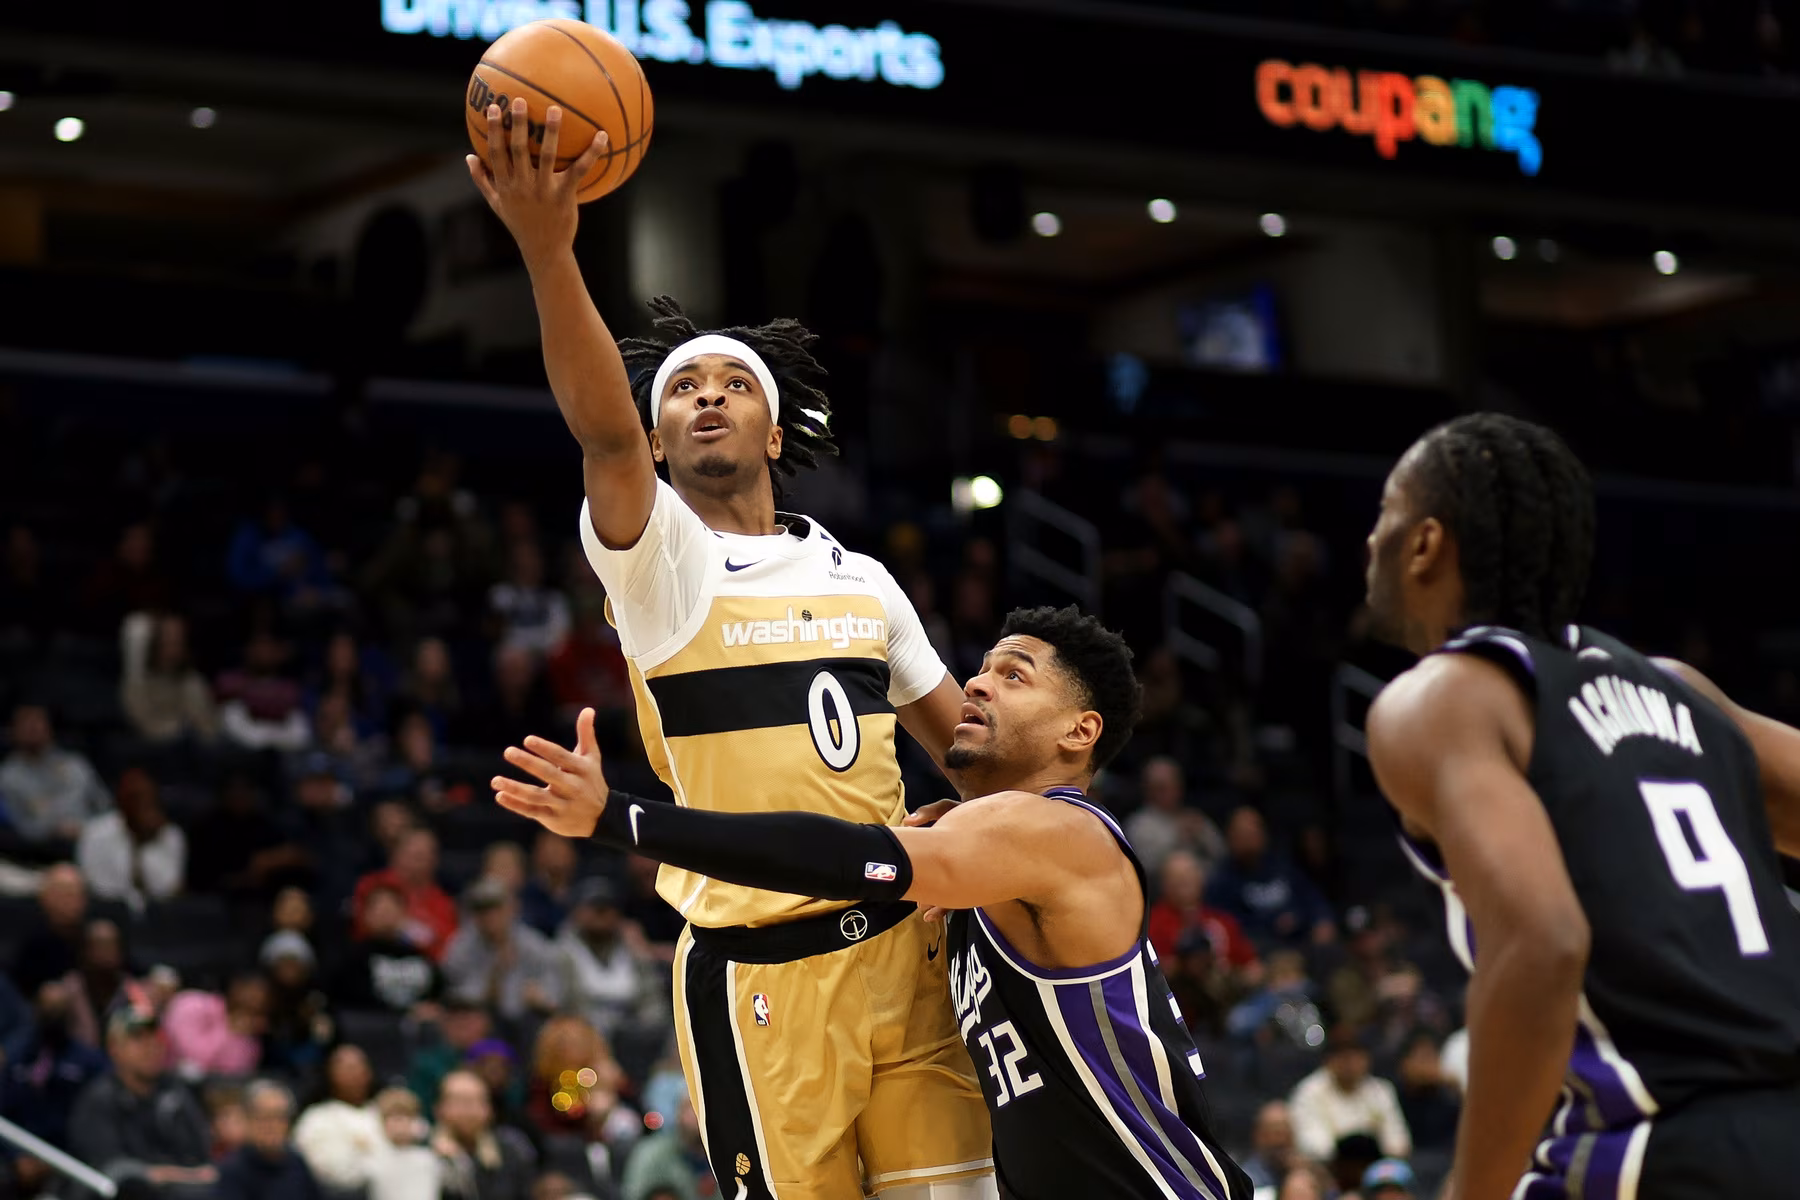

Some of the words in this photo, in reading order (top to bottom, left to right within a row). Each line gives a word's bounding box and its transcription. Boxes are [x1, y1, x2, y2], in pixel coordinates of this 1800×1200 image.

[706, 0, 945, 89] Exports
[1256, 59, 1543, 177] coupang
[721, 604, 886, 650] washington
[808, 667, 860, 772] 0
[1638, 779, 1771, 957] 9
[978, 1020, 1044, 1107] 32
